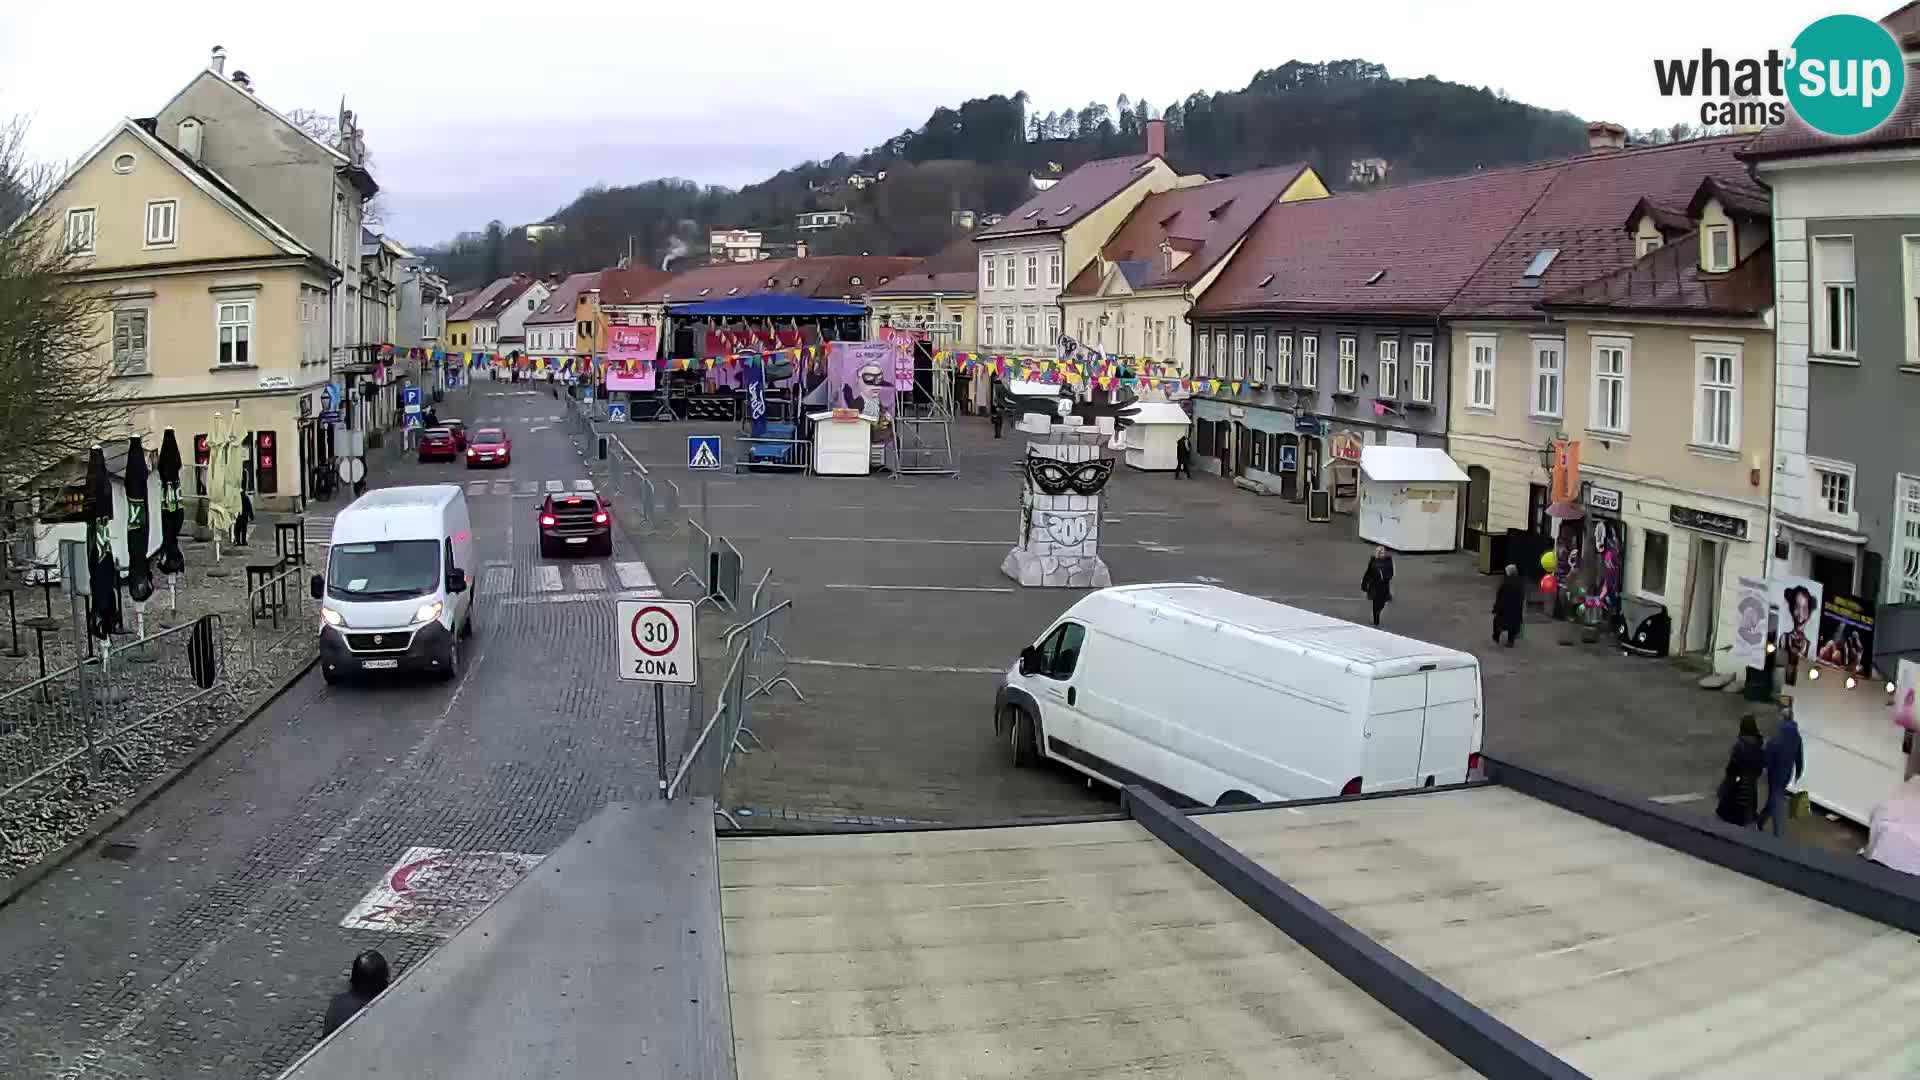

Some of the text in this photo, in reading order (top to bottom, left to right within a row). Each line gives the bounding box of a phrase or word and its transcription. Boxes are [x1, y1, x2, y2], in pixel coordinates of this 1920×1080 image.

[408, 391, 416, 403] P
[1049, 516, 1088, 546] 200
[644, 622, 668, 643] 30
[635, 659, 678, 676] ZONA
